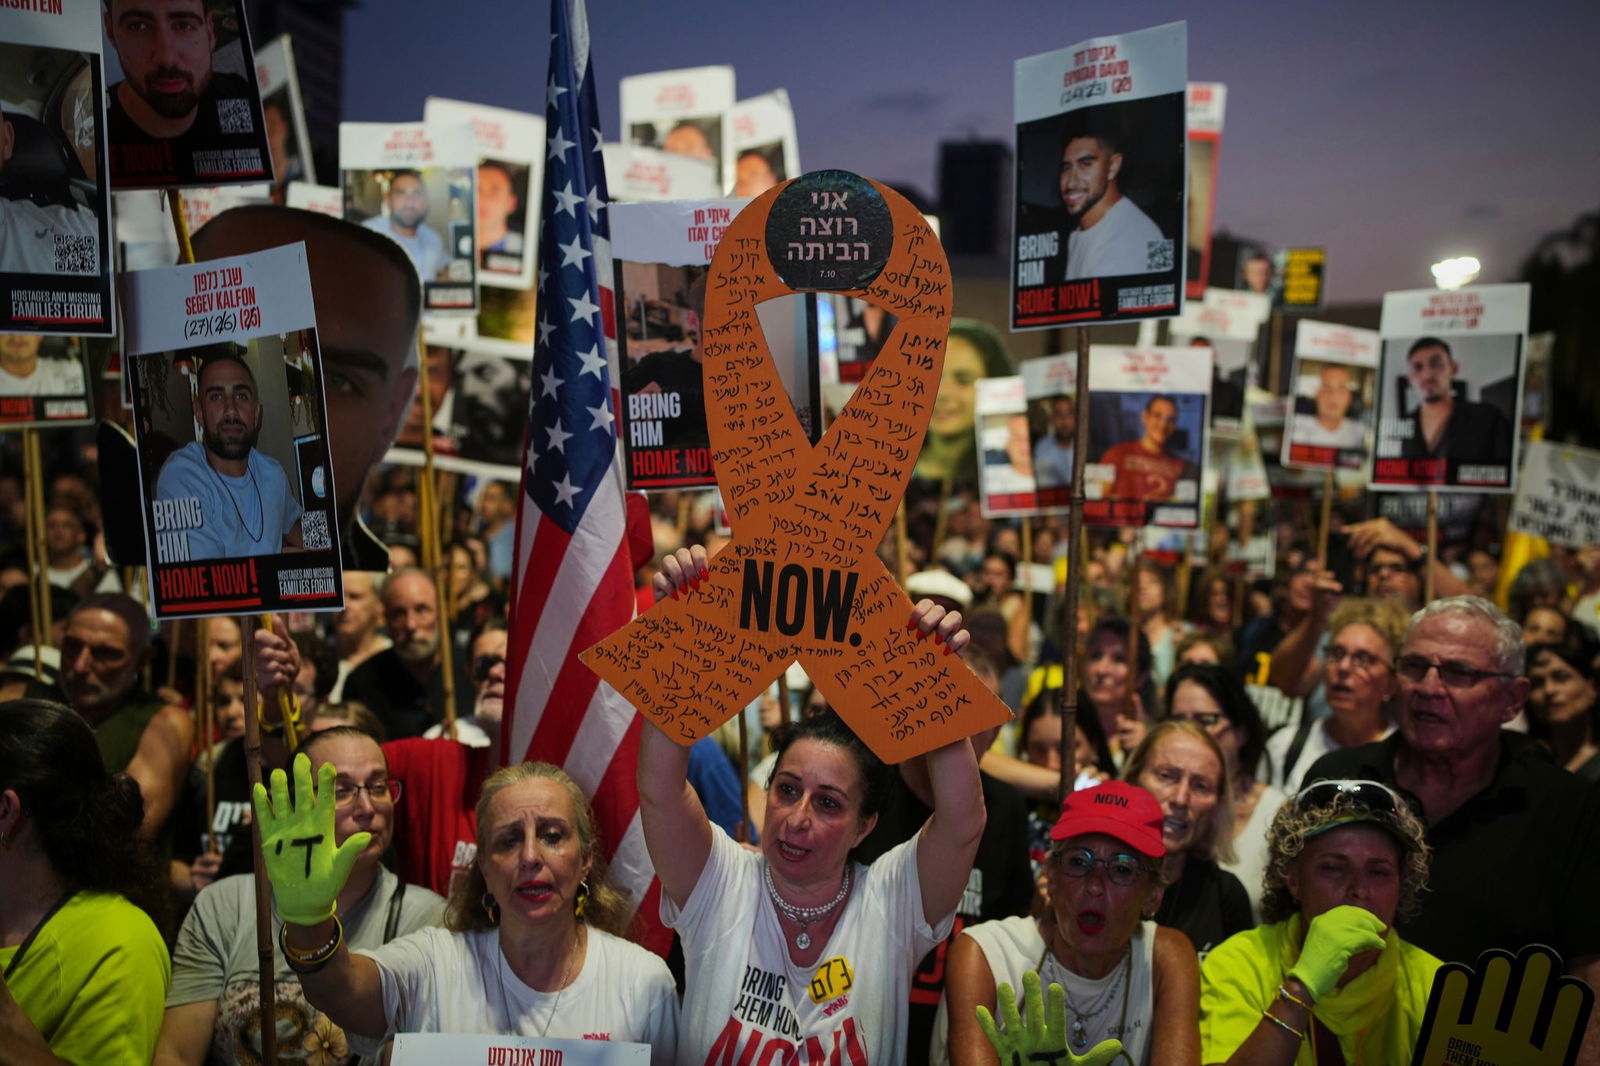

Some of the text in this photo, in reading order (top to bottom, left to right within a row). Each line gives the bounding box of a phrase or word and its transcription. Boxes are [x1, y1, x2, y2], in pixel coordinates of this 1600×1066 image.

[1100, 59, 1129, 78] DAVID
[194, 158, 263, 175] FAMILIES FORUM
[811, 191, 848, 211] אני
[694, 208, 730, 226] איתי חן
[799, 217, 859, 236] רוצה
[688, 226, 728, 242] ITAY CH
[736, 238, 761, 250] דוד
[787, 242, 870, 262] הביתה
[1018, 231, 1059, 261] BRING
[194, 266, 242, 295] שגב כלפון
[715, 273, 766, 289] אריאל
[819, 270, 836, 279] 7.10
[1018, 260, 1045, 287] HIM
[11, 289, 101, 304] HOSTAGES AND MISSING
[185, 286, 256, 315] SEGEV KALFON
[1017, 287, 1056, 315] HOME
[1058, 278, 1100, 311] NOW!
[12, 301, 102, 319] FAMILIES FORUM
[923, 304, 945, 319] גיא
[736, 341, 758, 352] גיא
[900, 332, 942, 350] איתן
[726, 356, 764, 371] עמירם
[901, 352, 933, 370] מור
[868, 366, 902, 388] ברמן
[745, 380, 772, 395] עידן
[628, 391, 681, 420] BRING
[755, 396, 775, 410] טל
[856, 386, 924, 416] זיו ברמן
[630, 420, 664, 448] HIM
[632, 448, 717, 477] HOME NO
[730, 448, 796, 477] דרור אור
[730, 467, 797, 500] שגב כלפון
[812, 463, 862, 489] דניאל
[764, 484, 795, 504] ענבר
[152, 499, 203, 532] BRING
[794, 503, 873, 539] תמיר אדר
[846, 501, 881, 523] אלון
[157, 531, 191, 564] HIM
[784, 541, 815, 561] מירן
[832, 537, 863, 554] רום
[160, 557, 259, 600] HOME NOW!
[279, 578, 335, 595] FAMILIES FORUM
[710, 584, 734, 598] הדר
[739, 558, 864, 647] NOW.
[907, 652, 936, 670] סהר
[725, 668, 752, 685] תמיר
[871, 692, 900, 710] דוד
[930, 694, 972, 725] אסף
[680, 721, 697, 739] בר
[1094, 792, 1129, 809] NOW
[488, 1046, 563, 1066] מתן אנגרסט
[1447, 1037, 1482, 1058] BRING
